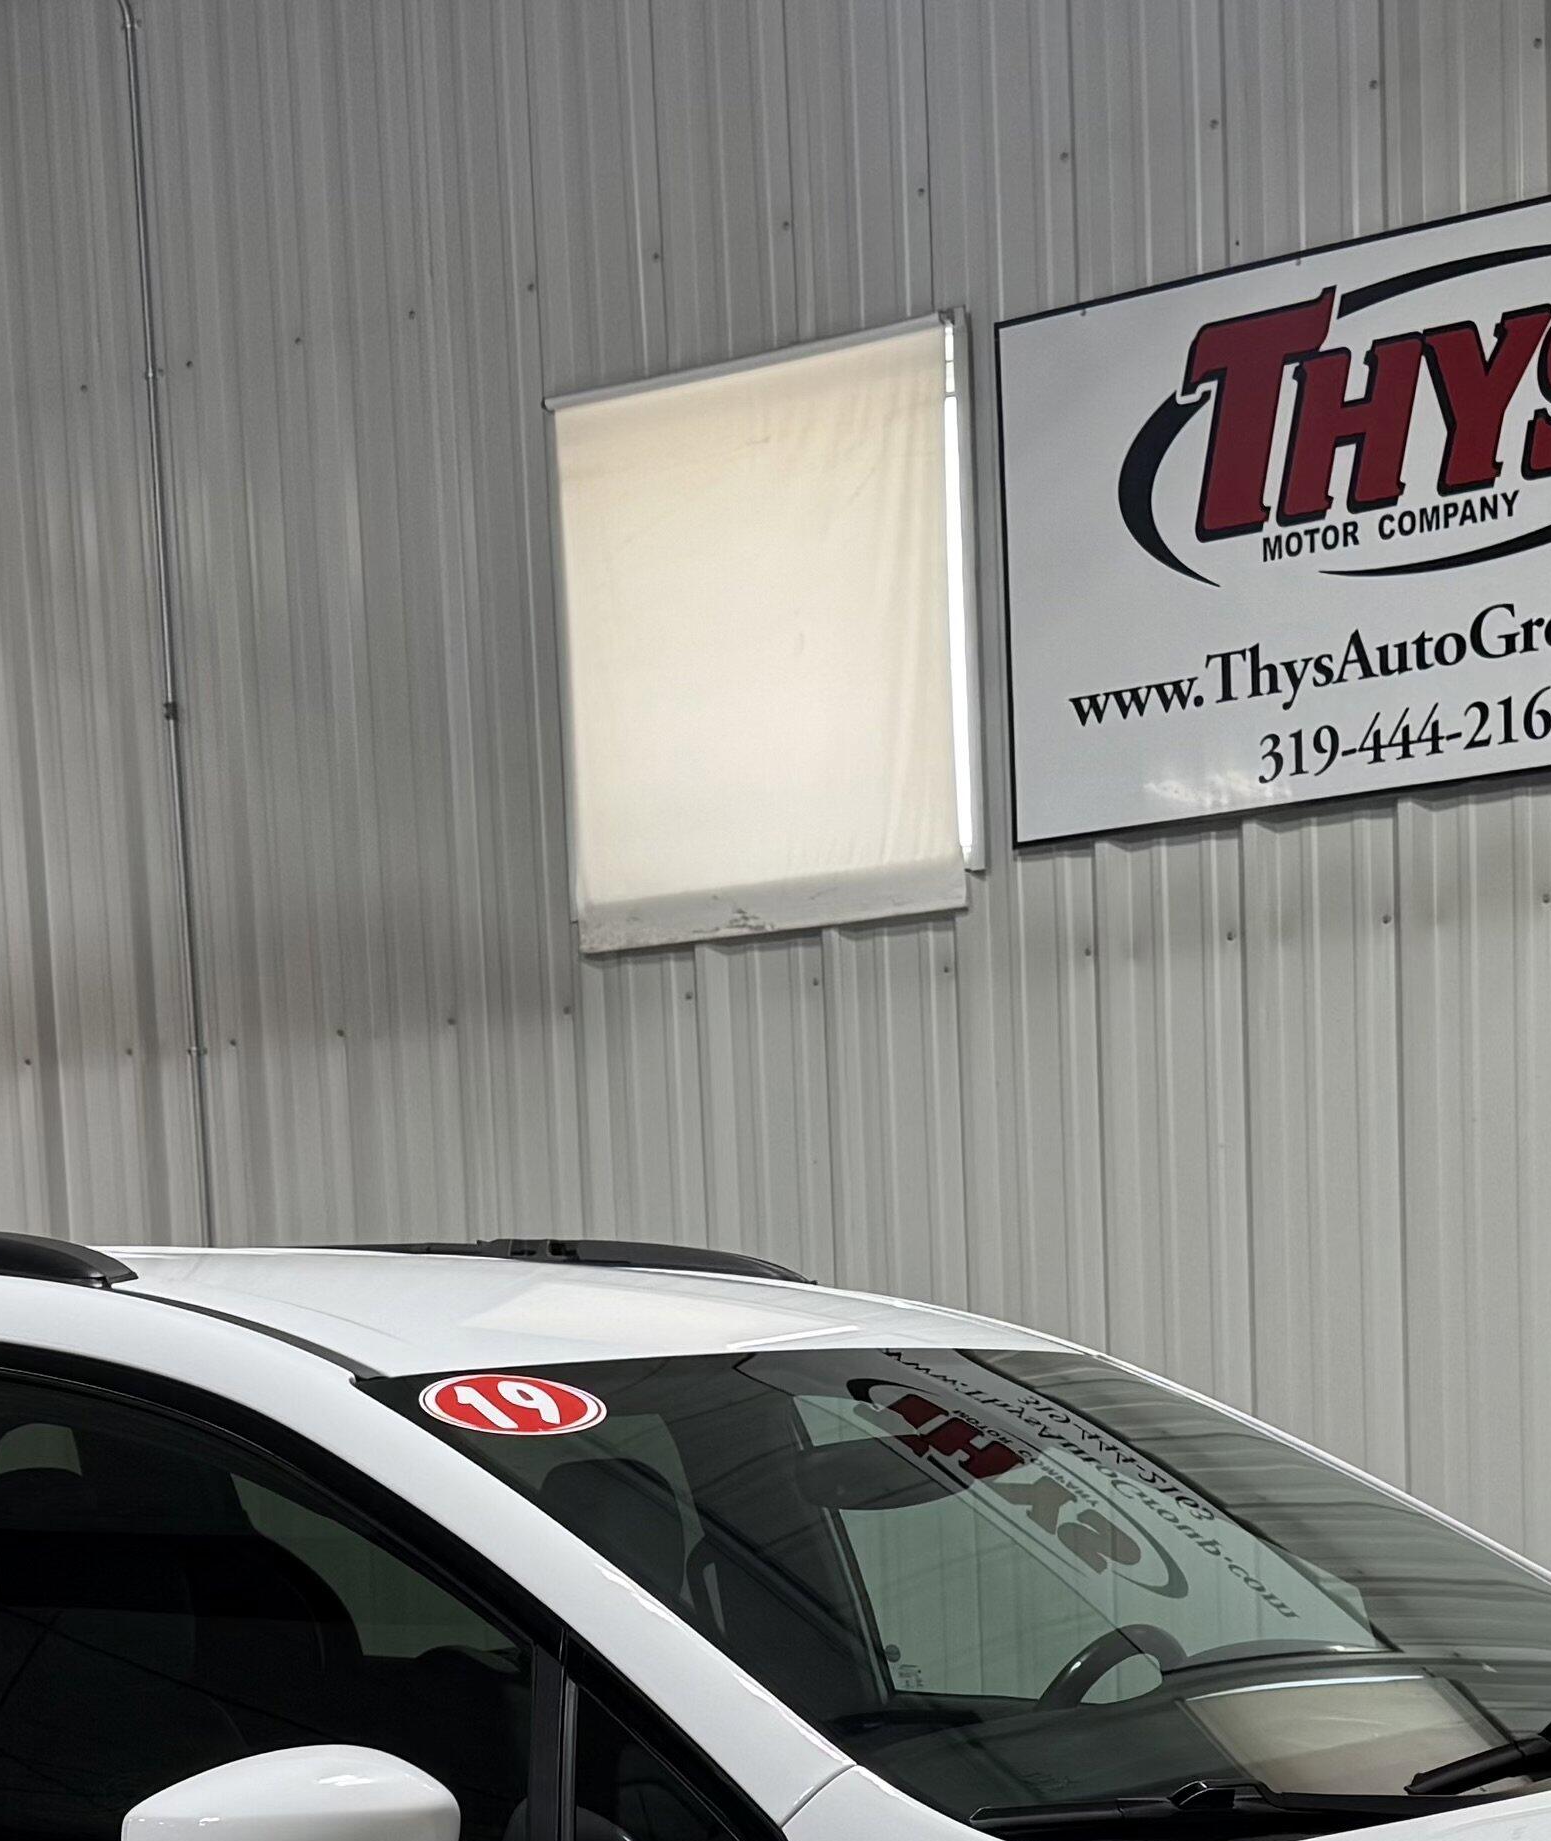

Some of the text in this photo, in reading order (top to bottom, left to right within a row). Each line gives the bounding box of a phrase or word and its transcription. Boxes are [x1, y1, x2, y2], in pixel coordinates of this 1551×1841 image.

[1262, 490, 1520, 562] MOTOR COMPANY
[454, 1381, 561, 1429] 19
